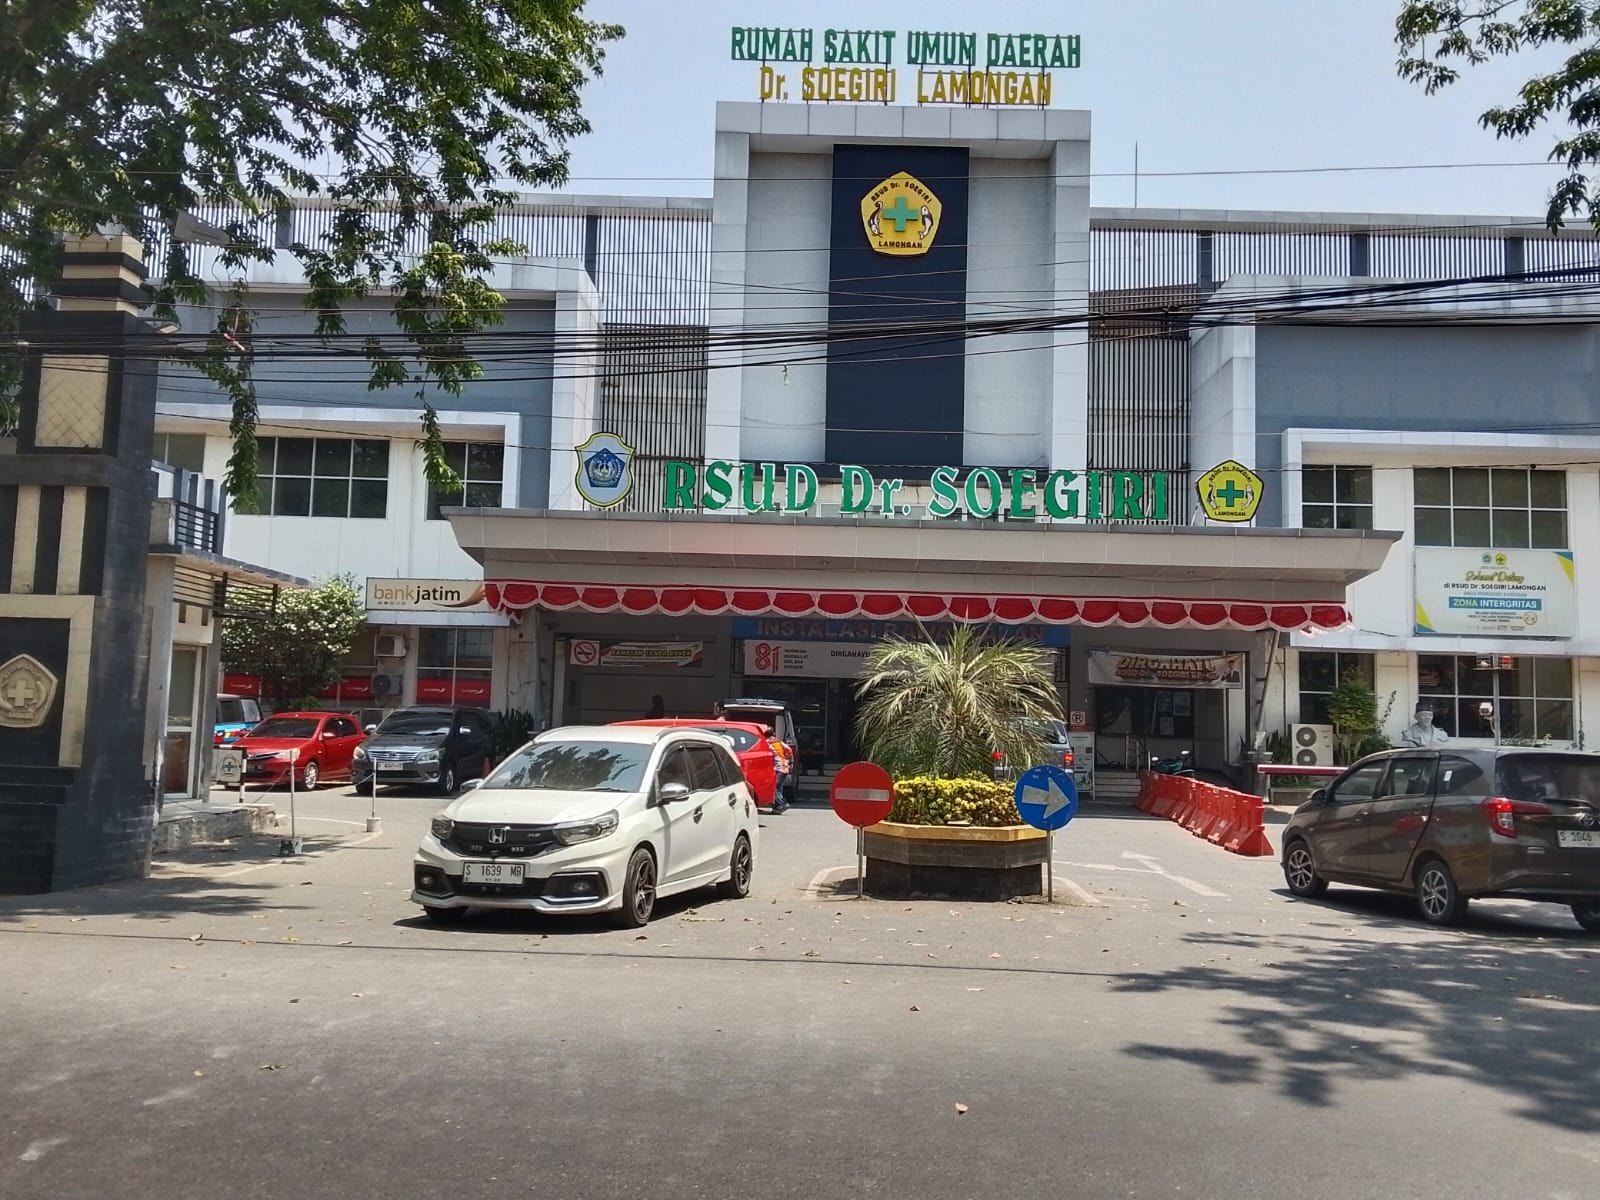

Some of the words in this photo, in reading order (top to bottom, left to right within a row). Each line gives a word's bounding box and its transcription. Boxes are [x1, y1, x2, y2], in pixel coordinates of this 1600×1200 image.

[731, 27, 813, 61] RUMAH
[824, 29, 896, 64] SAKIT
[907, 31, 976, 66] UMUM
[987, 33, 1080, 68] DAERAH
[760, 66, 788, 99] Dr.
[802, 67, 896, 102] SOEGIRI
[918, 70, 1052, 106] LAMONGAN
[871, 186, 889, 202] RSUD
[890, 182, 900, 190] Dr.
[904, 182, 933, 204] SOEGIRI
[878, 240, 923, 249] LAMONGAN
[663, 461, 818, 514] RSUD
[840, 465, 911, 516] Dr.
[927, 466, 1169, 520] SOEGIRI
[1453, 598, 1478, 607] ZONA
[1480, 599, 1538, 609] INTERGRITAS
[757, 619, 877, 638] INSTALASI
[755, 642, 781, 674] 81
[830, 650, 871, 658] DIRGAHAYU
[1116, 655, 1217, 671] DIRGAHAYU
[1560, 831, 1567, 841] S
[465, 865, 471, 875] S
[481, 865, 502, 877] 1639
